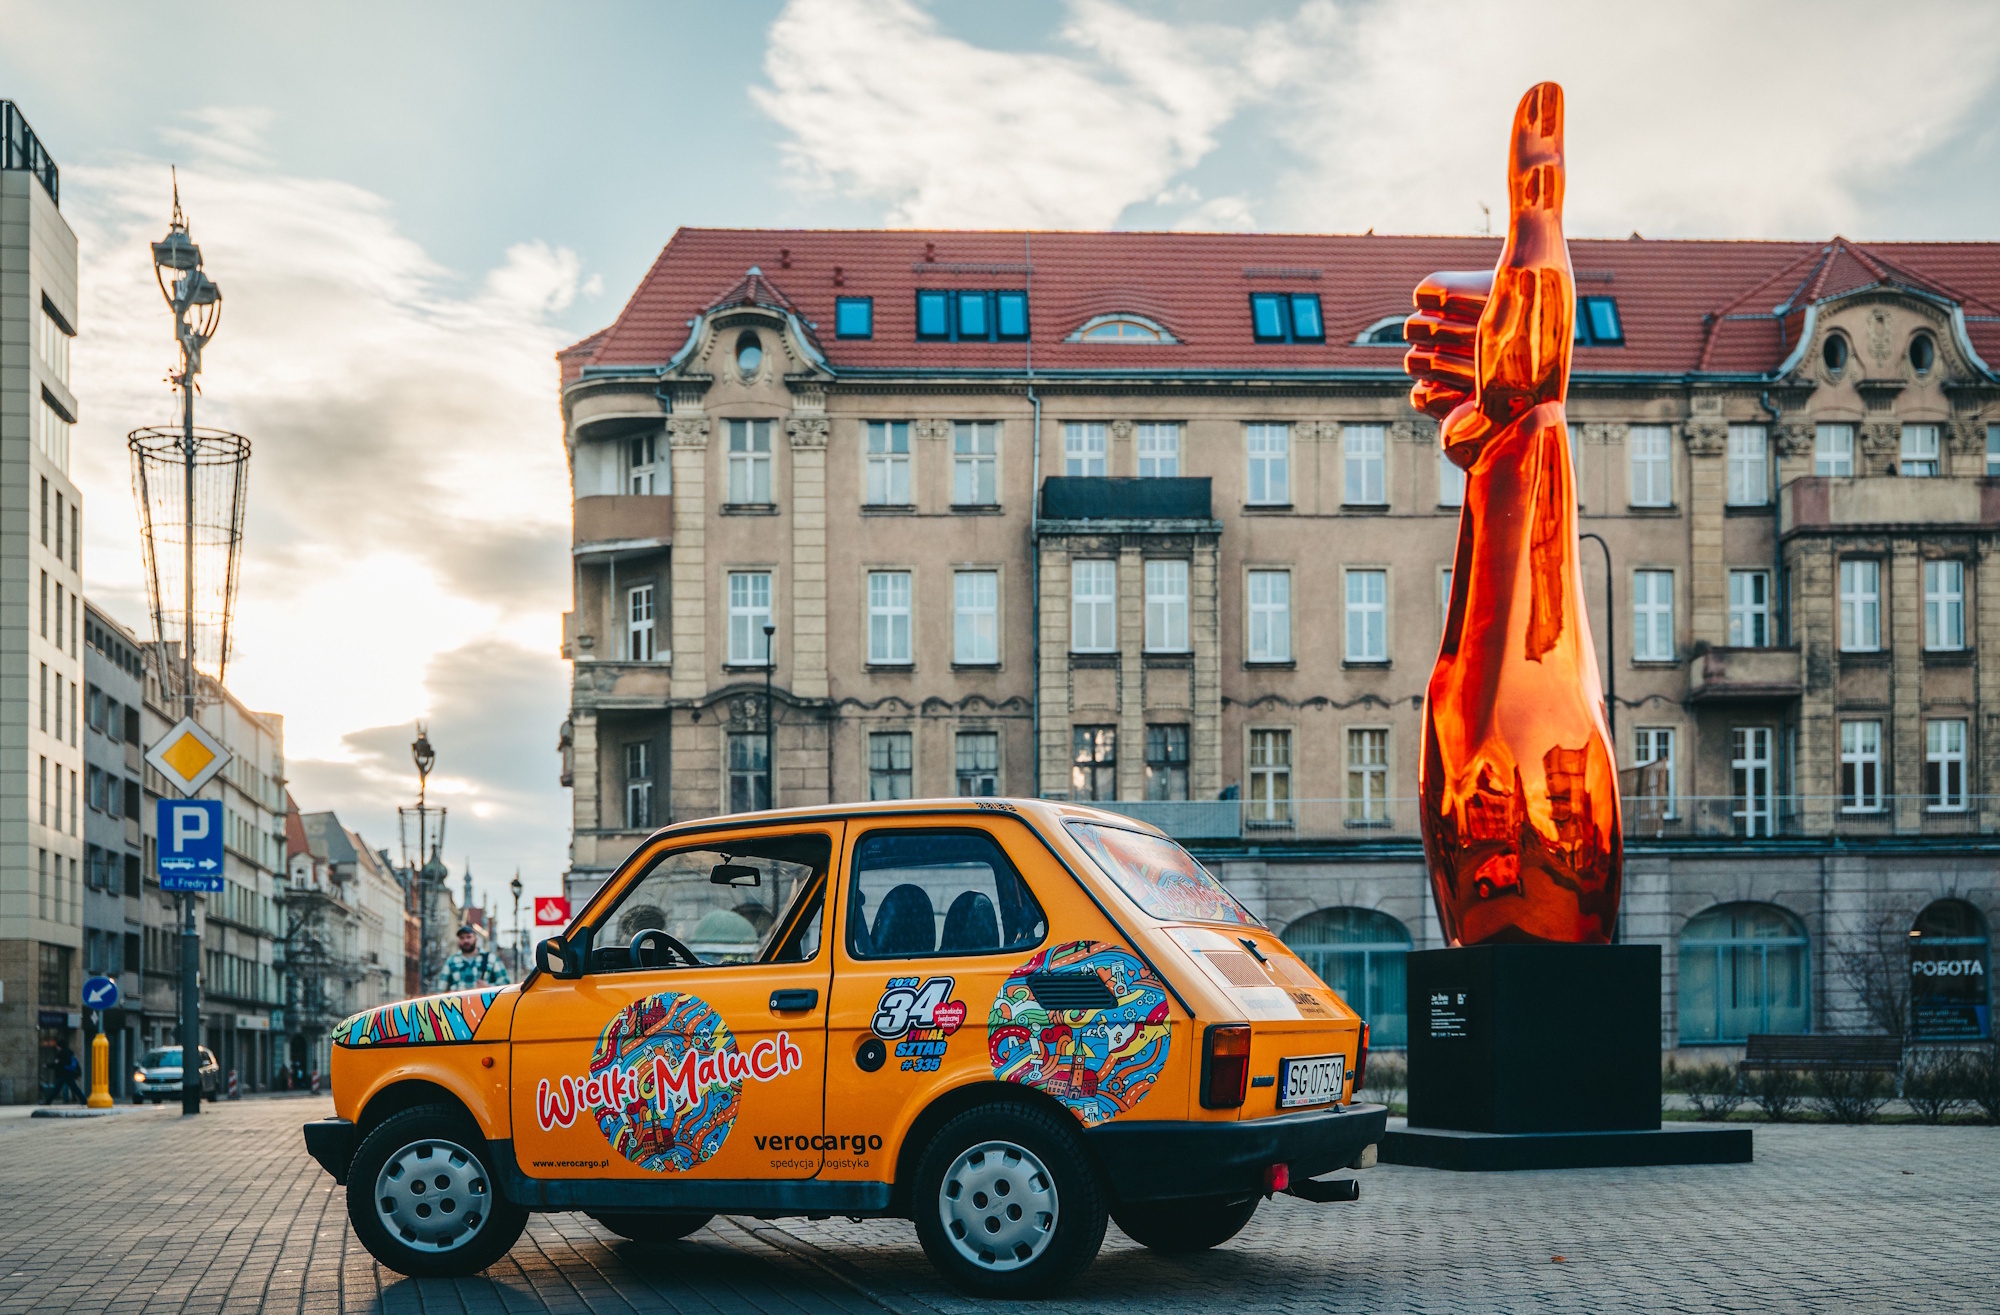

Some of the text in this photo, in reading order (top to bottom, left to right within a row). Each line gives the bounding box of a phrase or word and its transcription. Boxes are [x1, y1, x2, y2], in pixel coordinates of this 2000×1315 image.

[173, 806, 209, 852] P
[178, 877, 208, 892] Fredry
[1912, 960, 1984, 976] РОБОТА
[886, 977, 919, 988] 2026
[874, 979, 952, 1036] 34
[895, 1042, 947, 1056] SZTAB
[1290, 1062, 1342, 1096] SG 07529
[537, 1065, 638, 1131] Wielki
[754, 1134, 882, 1155] verocargo
[533, 1159, 609, 1170] www.verocargo.pl
[771, 1159, 813, 1169] spedycja
